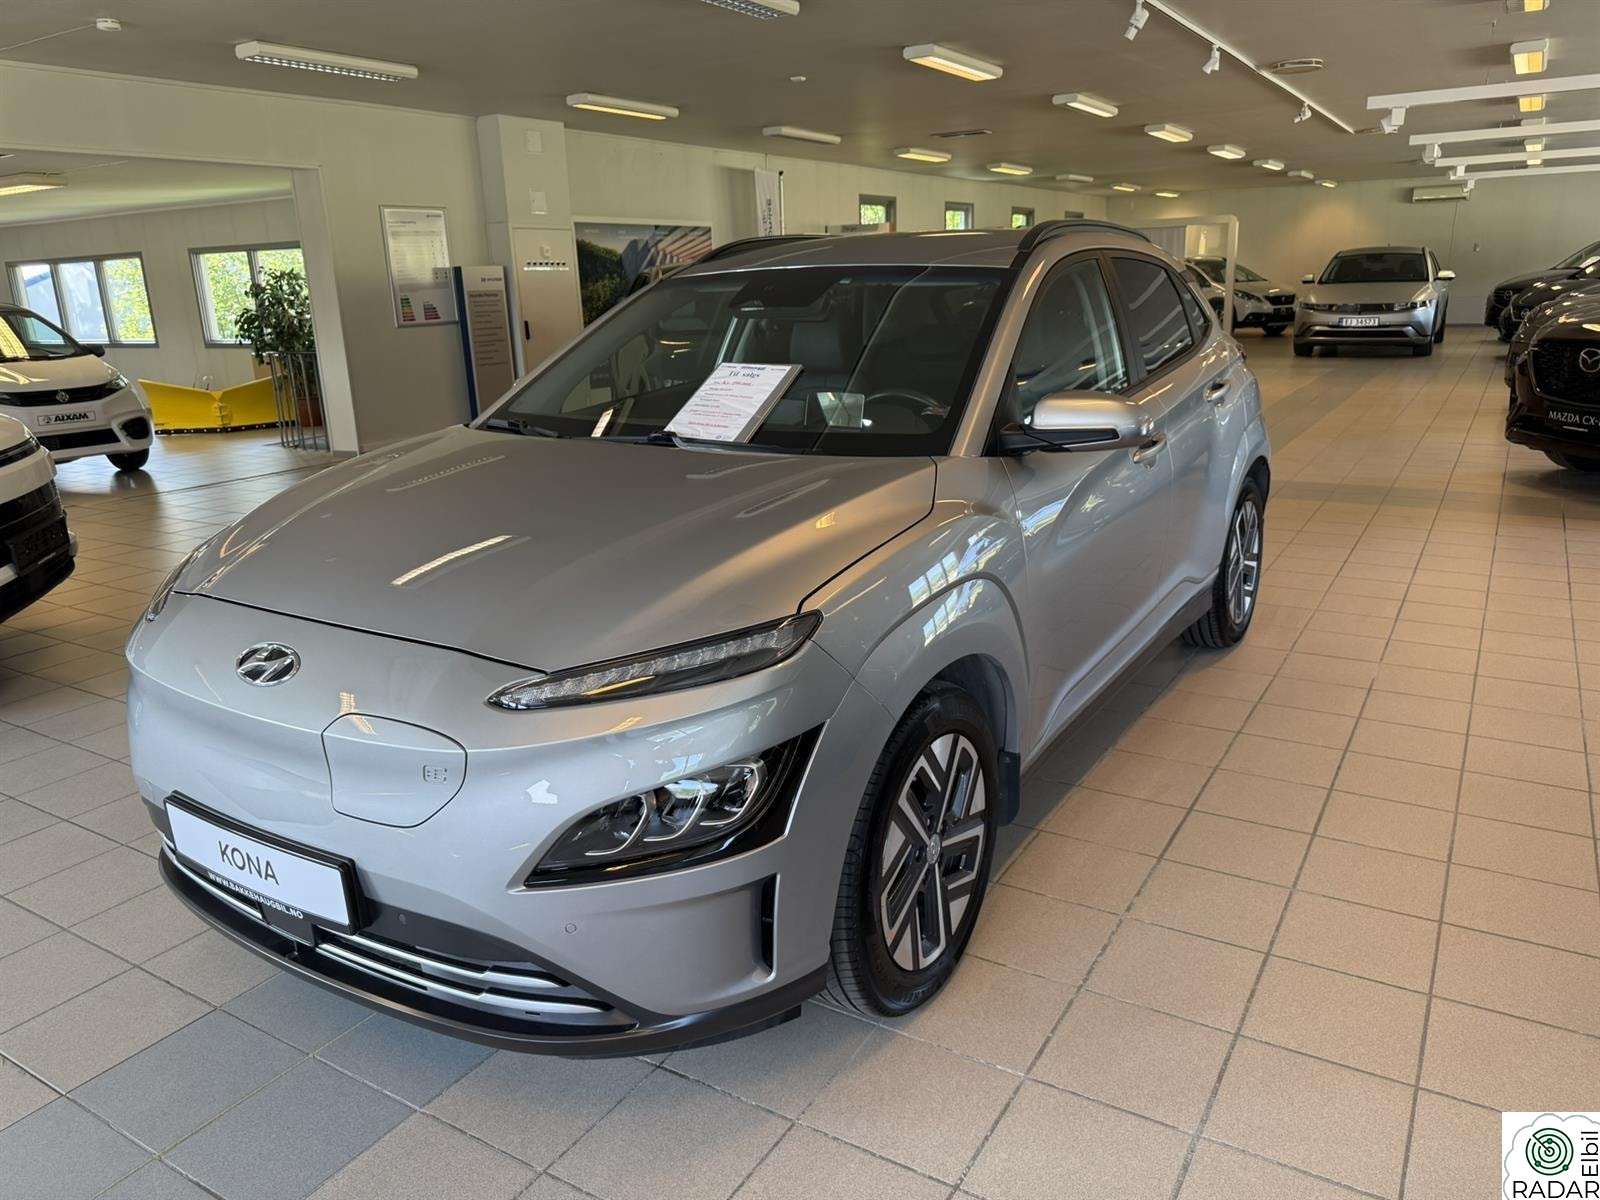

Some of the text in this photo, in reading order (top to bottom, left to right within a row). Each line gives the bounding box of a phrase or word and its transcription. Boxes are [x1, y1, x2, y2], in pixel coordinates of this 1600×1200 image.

[54, 412, 90, 422] AIXAM
[1548, 410, 1580, 424] MAZDA
[218, 840, 280, 886] KONA
[207, 871, 304, 919] WWW.BAKKEHAUGBIL.NO
